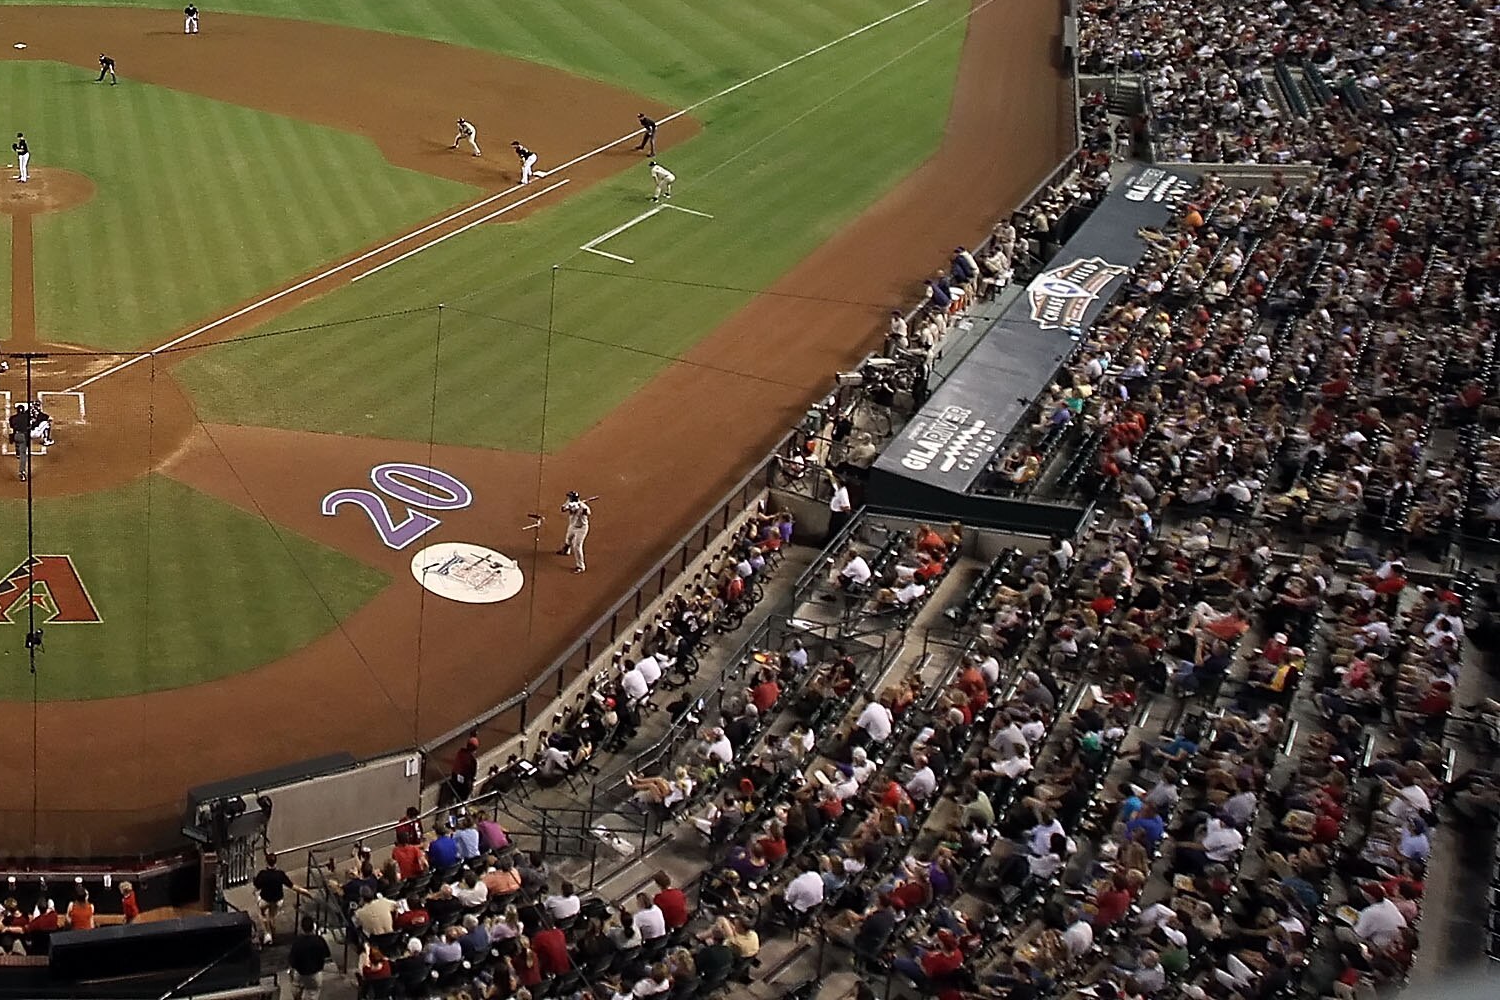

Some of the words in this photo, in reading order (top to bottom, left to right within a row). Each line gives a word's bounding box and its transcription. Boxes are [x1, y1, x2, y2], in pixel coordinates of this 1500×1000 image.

[1067, 264, 1099, 283] FIELD
[1042, 296, 1066, 320] CHASE
[901, 440, 944, 470] GILA
[923, 405, 972, 444] RIVER
[958, 429, 997, 470] CASINOS
[321, 462, 474, 551] 20
